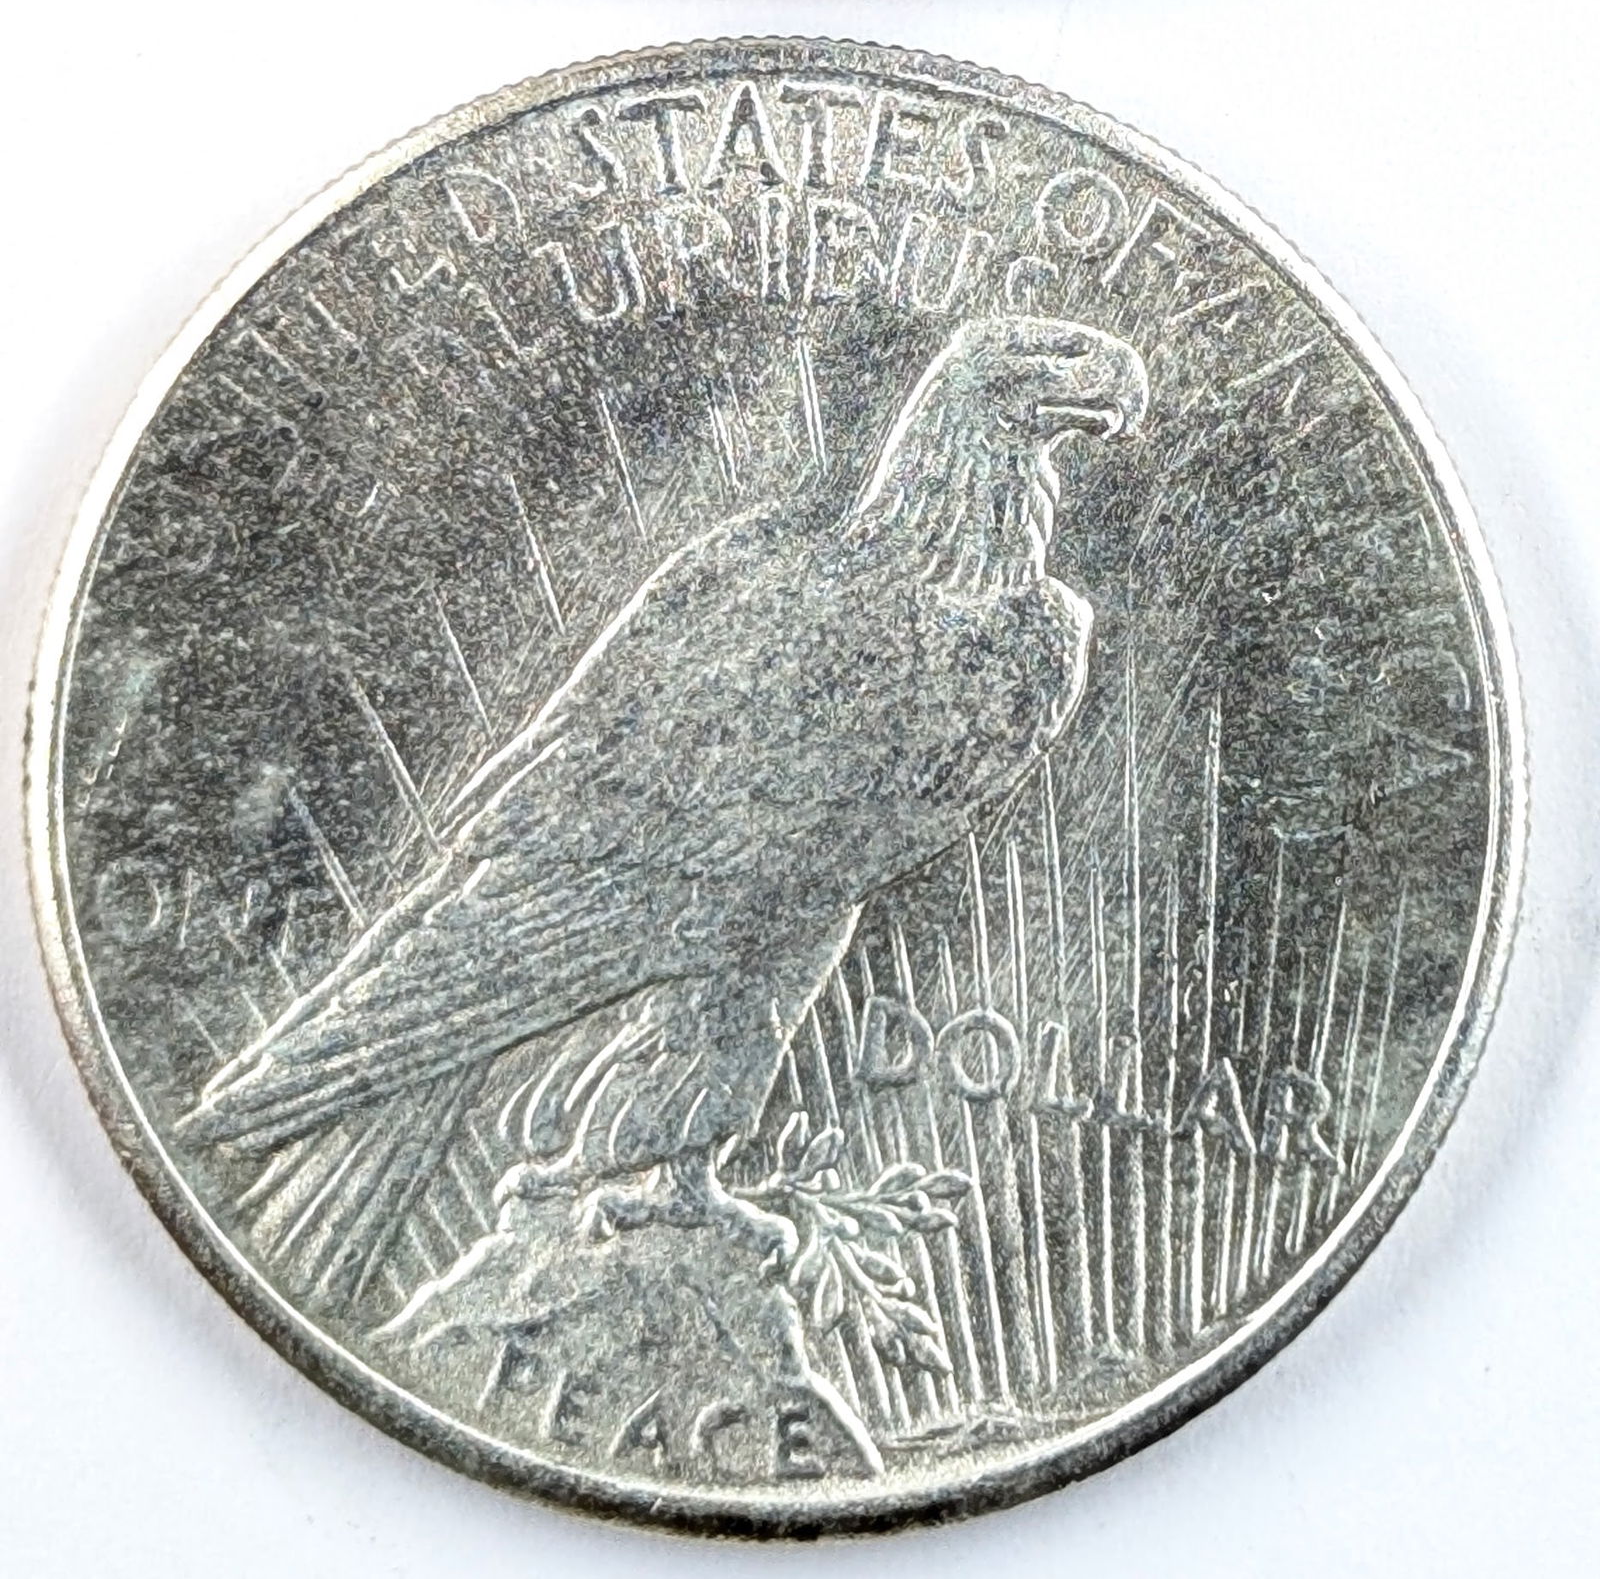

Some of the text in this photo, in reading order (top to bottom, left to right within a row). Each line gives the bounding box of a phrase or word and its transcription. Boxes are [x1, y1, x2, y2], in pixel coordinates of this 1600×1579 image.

[565, 78, 1006, 199] STATES
[1033, 165, 1210, 287] OF
[855, 995, 1345, 1172] DOLLAR
[475, 1337, 828, 1480] PEACE
